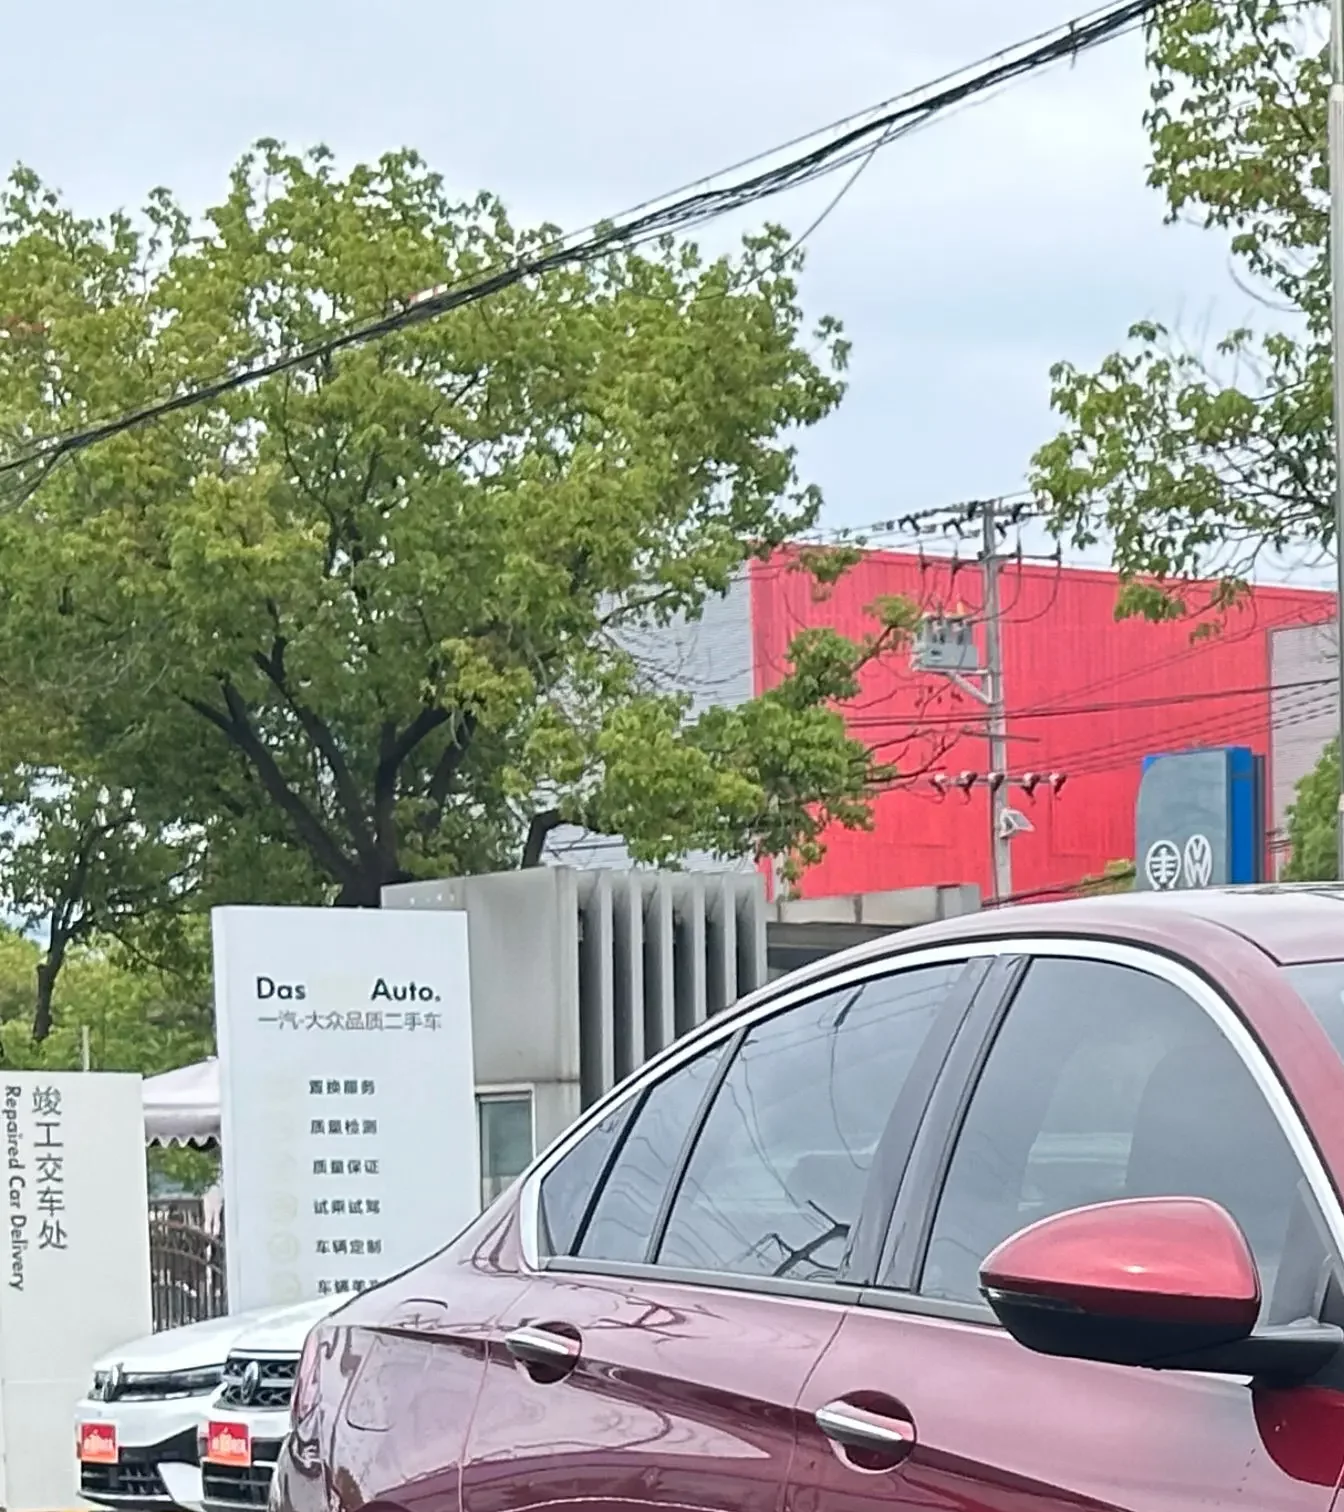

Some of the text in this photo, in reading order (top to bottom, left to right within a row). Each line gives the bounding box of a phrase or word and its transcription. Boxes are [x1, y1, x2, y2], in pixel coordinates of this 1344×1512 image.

[256, 975, 441, 1002] Das Auto.
[2, 1085, 29, 1292] Repaired Car Delivery
[32, 1085, 68, 1250] 竣工交车处
[313, 1159, 379, 1174] 质量保证
